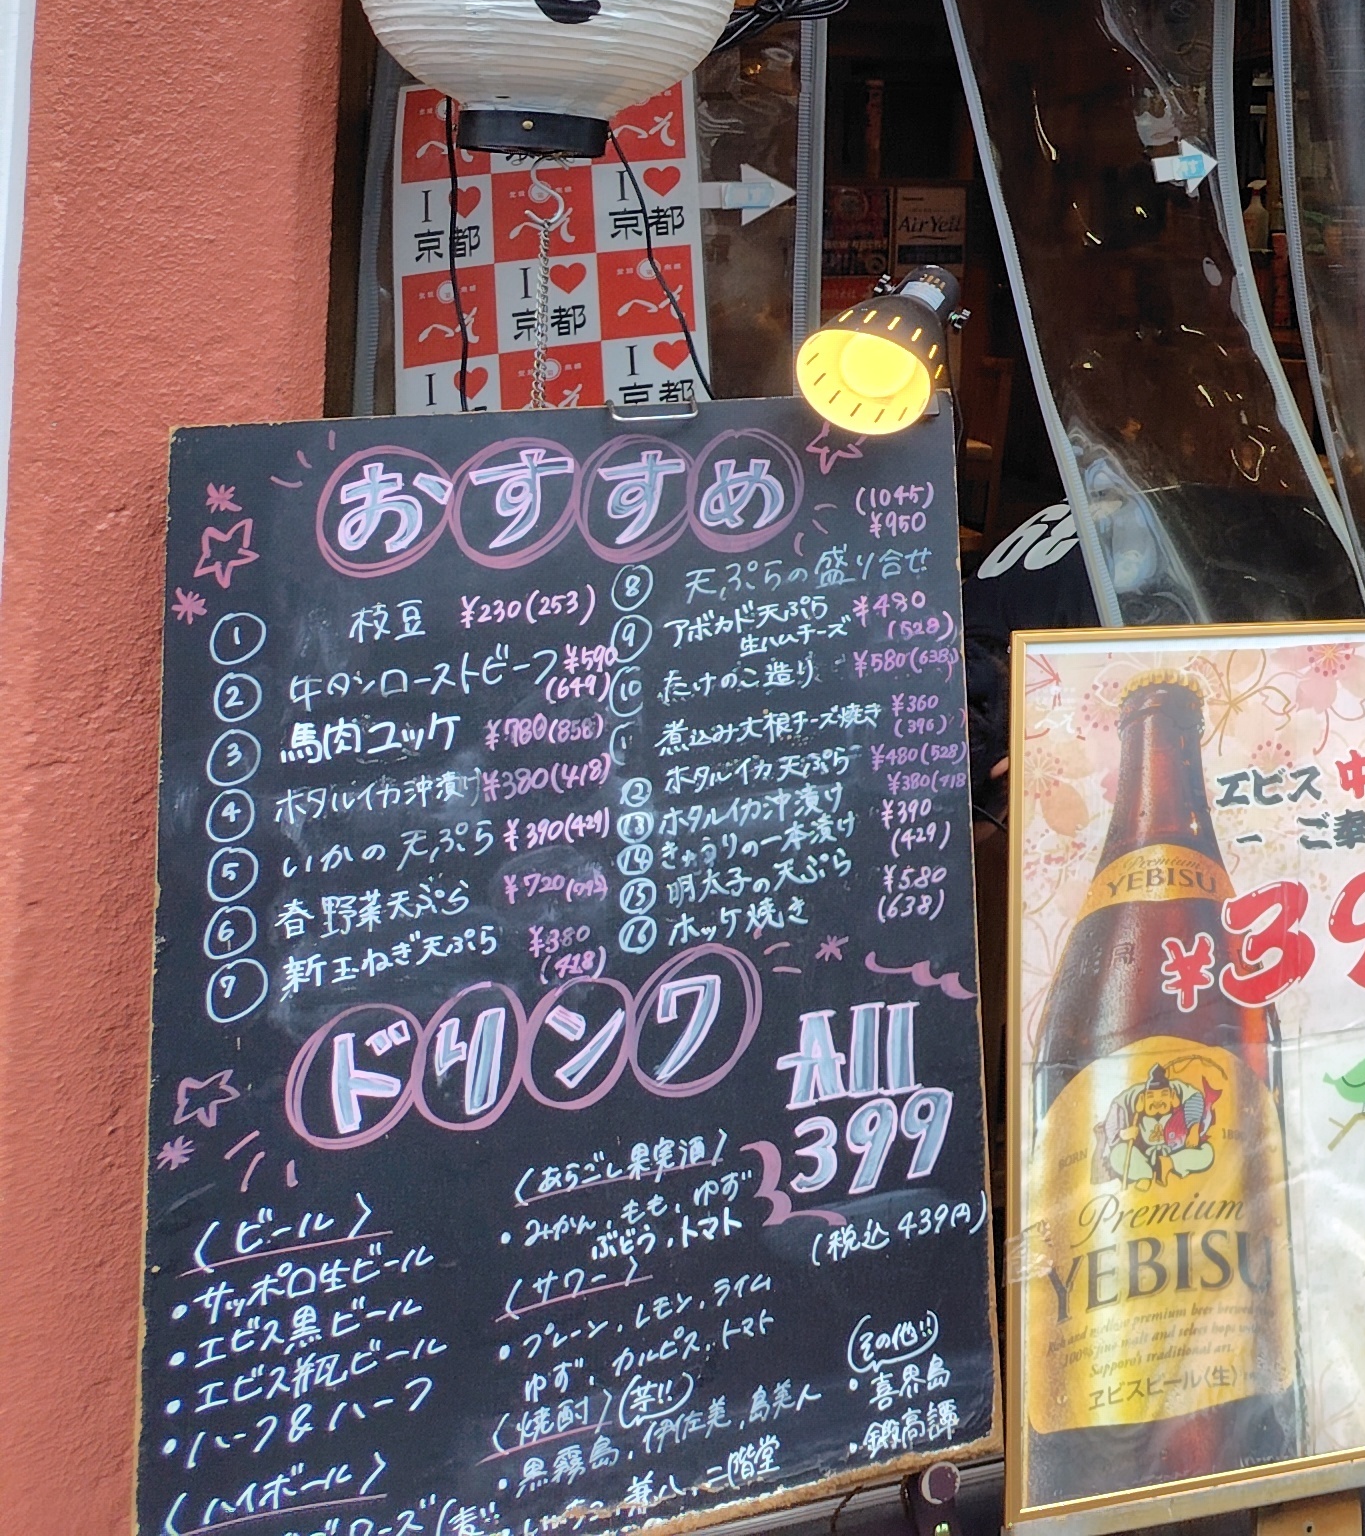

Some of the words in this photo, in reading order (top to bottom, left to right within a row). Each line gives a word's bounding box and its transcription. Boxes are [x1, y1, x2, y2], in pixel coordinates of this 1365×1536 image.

[414, 224, 481, 264] 京都
[609, 205, 684, 240] 京都
[338, 449, 785, 553] おすすめ
[685, 544, 933, 604] 天ぷらの盛り合せ
[349, 600, 427, 643] 枝豆
[664, 596, 829, 649] アボカド天ぷら
[739, 614, 852, 658] 生ハムチーズ
[290, 643, 558, 712] 牛タンローストビーフ
[281, 713, 462, 764] 馬肉ユッケ
[1215, 766, 1322, 810] エビス
[283, 819, 495, 880] いかの天ぷら
[667, 847, 853, 909] 明太子の天ぷら
[1107, 868, 1218, 899] YEBISU
[668, 895, 810, 946] ホッケ焼き
[332, 976, 721, 1134] ドリンク
[791, 1088, 954, 1195] 399
[1071, 1192, 1244, 1250] Premium
[1048, 1228, 1273, 1325] YEBISU
[1146, 1342, 1212, 1365] traditional
[867, 1353, 952, 1412] 喜界島
